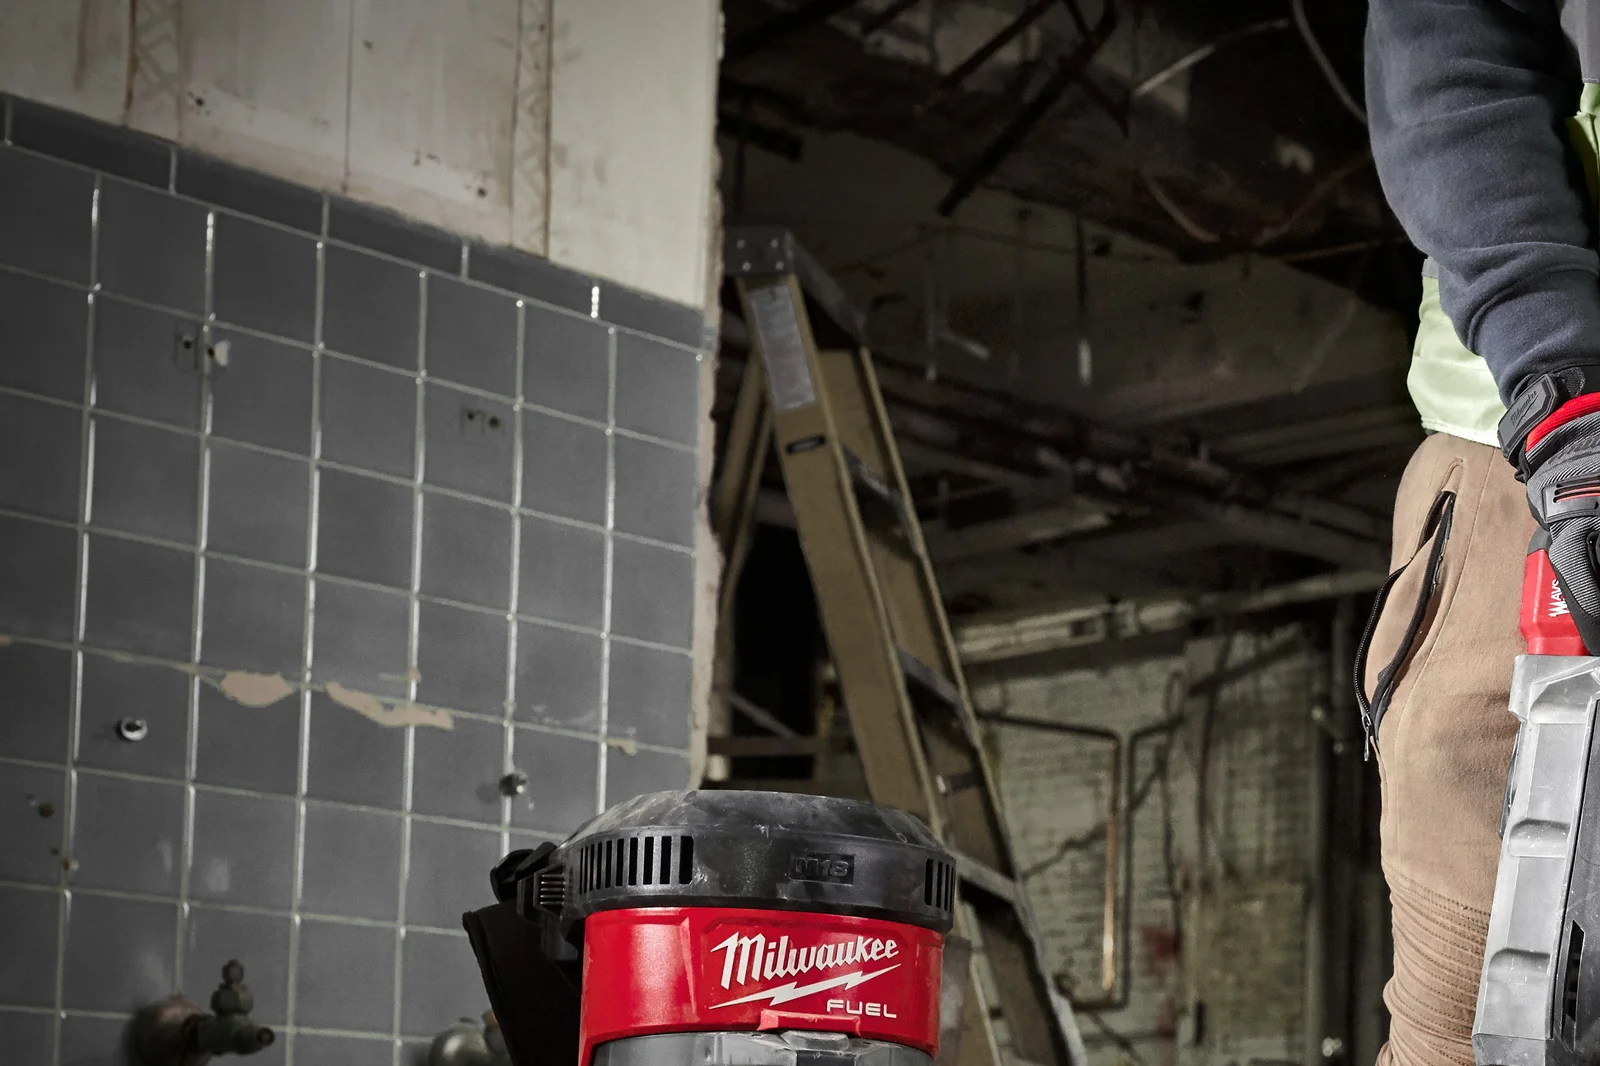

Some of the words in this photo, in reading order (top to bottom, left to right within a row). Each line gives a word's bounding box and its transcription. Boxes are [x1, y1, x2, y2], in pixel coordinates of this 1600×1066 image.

[796, 857, 849, 877] M18
[710, 931, 899, 989] Milwaukee
[826, 999, 897, 1019] FUEL
